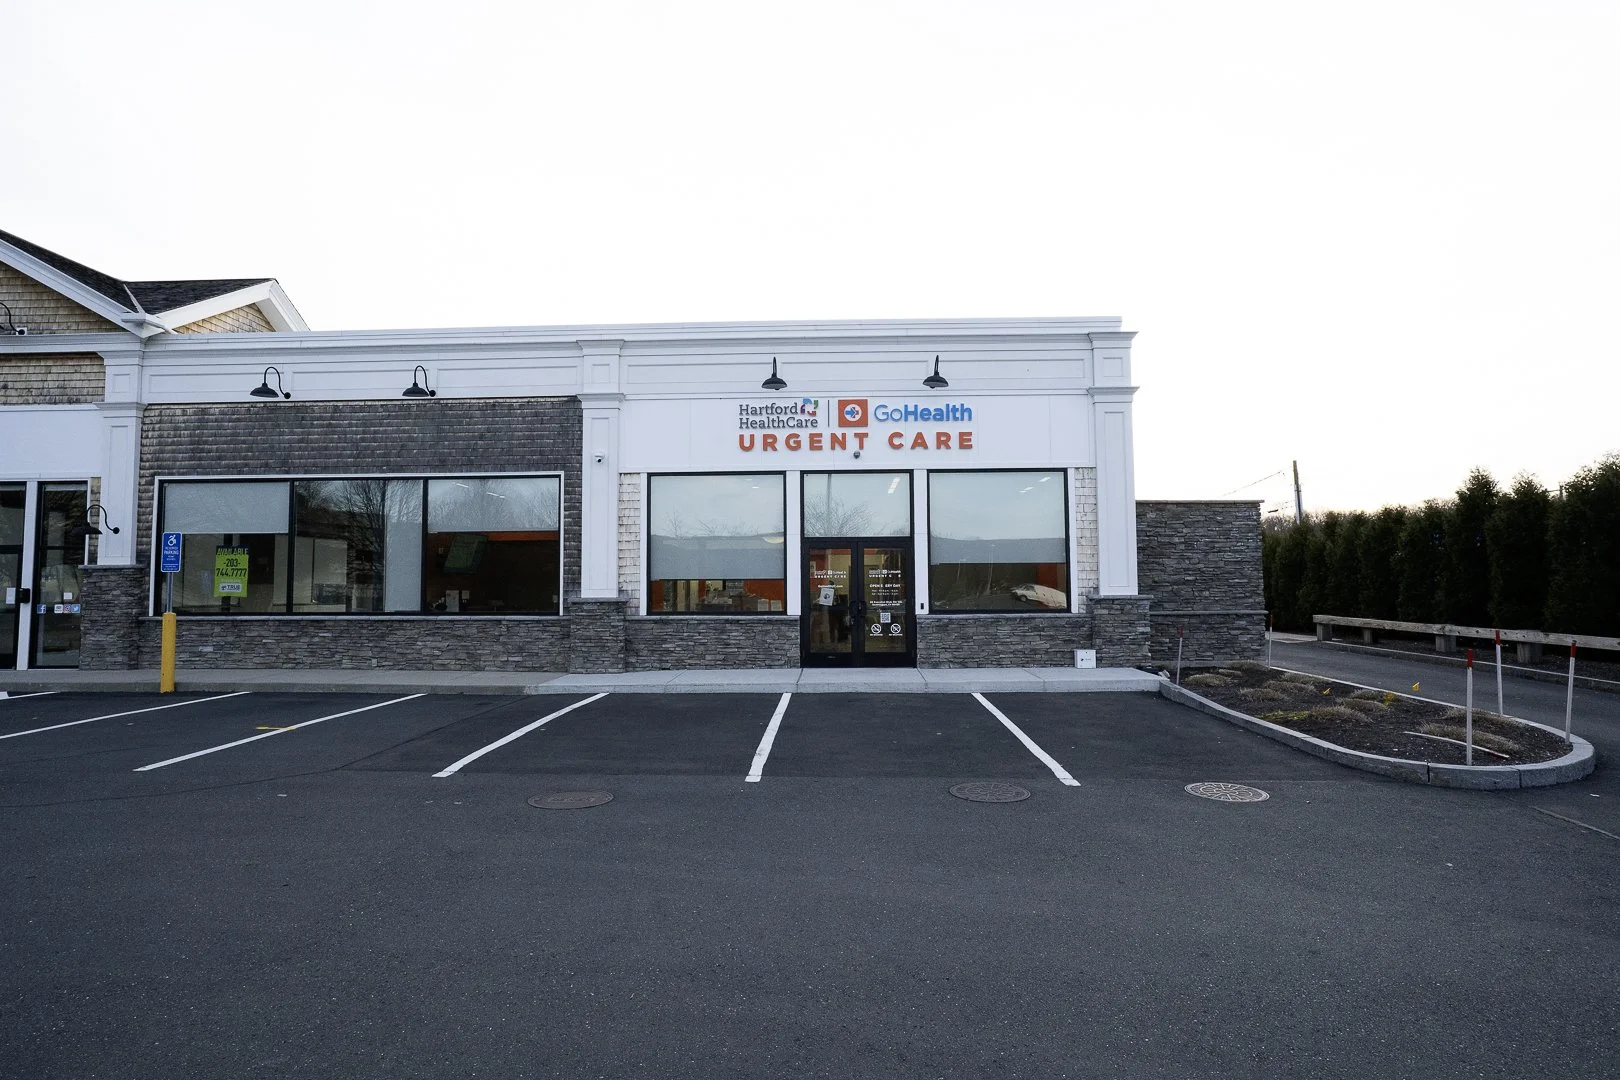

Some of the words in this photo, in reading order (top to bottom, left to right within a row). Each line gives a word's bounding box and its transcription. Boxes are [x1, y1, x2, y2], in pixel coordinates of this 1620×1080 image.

[738, 402, 798, 415] Hartford
[873, 403, 973, 422] GoHealth
[738, 416, 818, 429] HealthCare
[738, 432, 869, 451] URGENT
[887, 431, 973, 450] CARE
[215, 568, 248, 577] 744.7777
